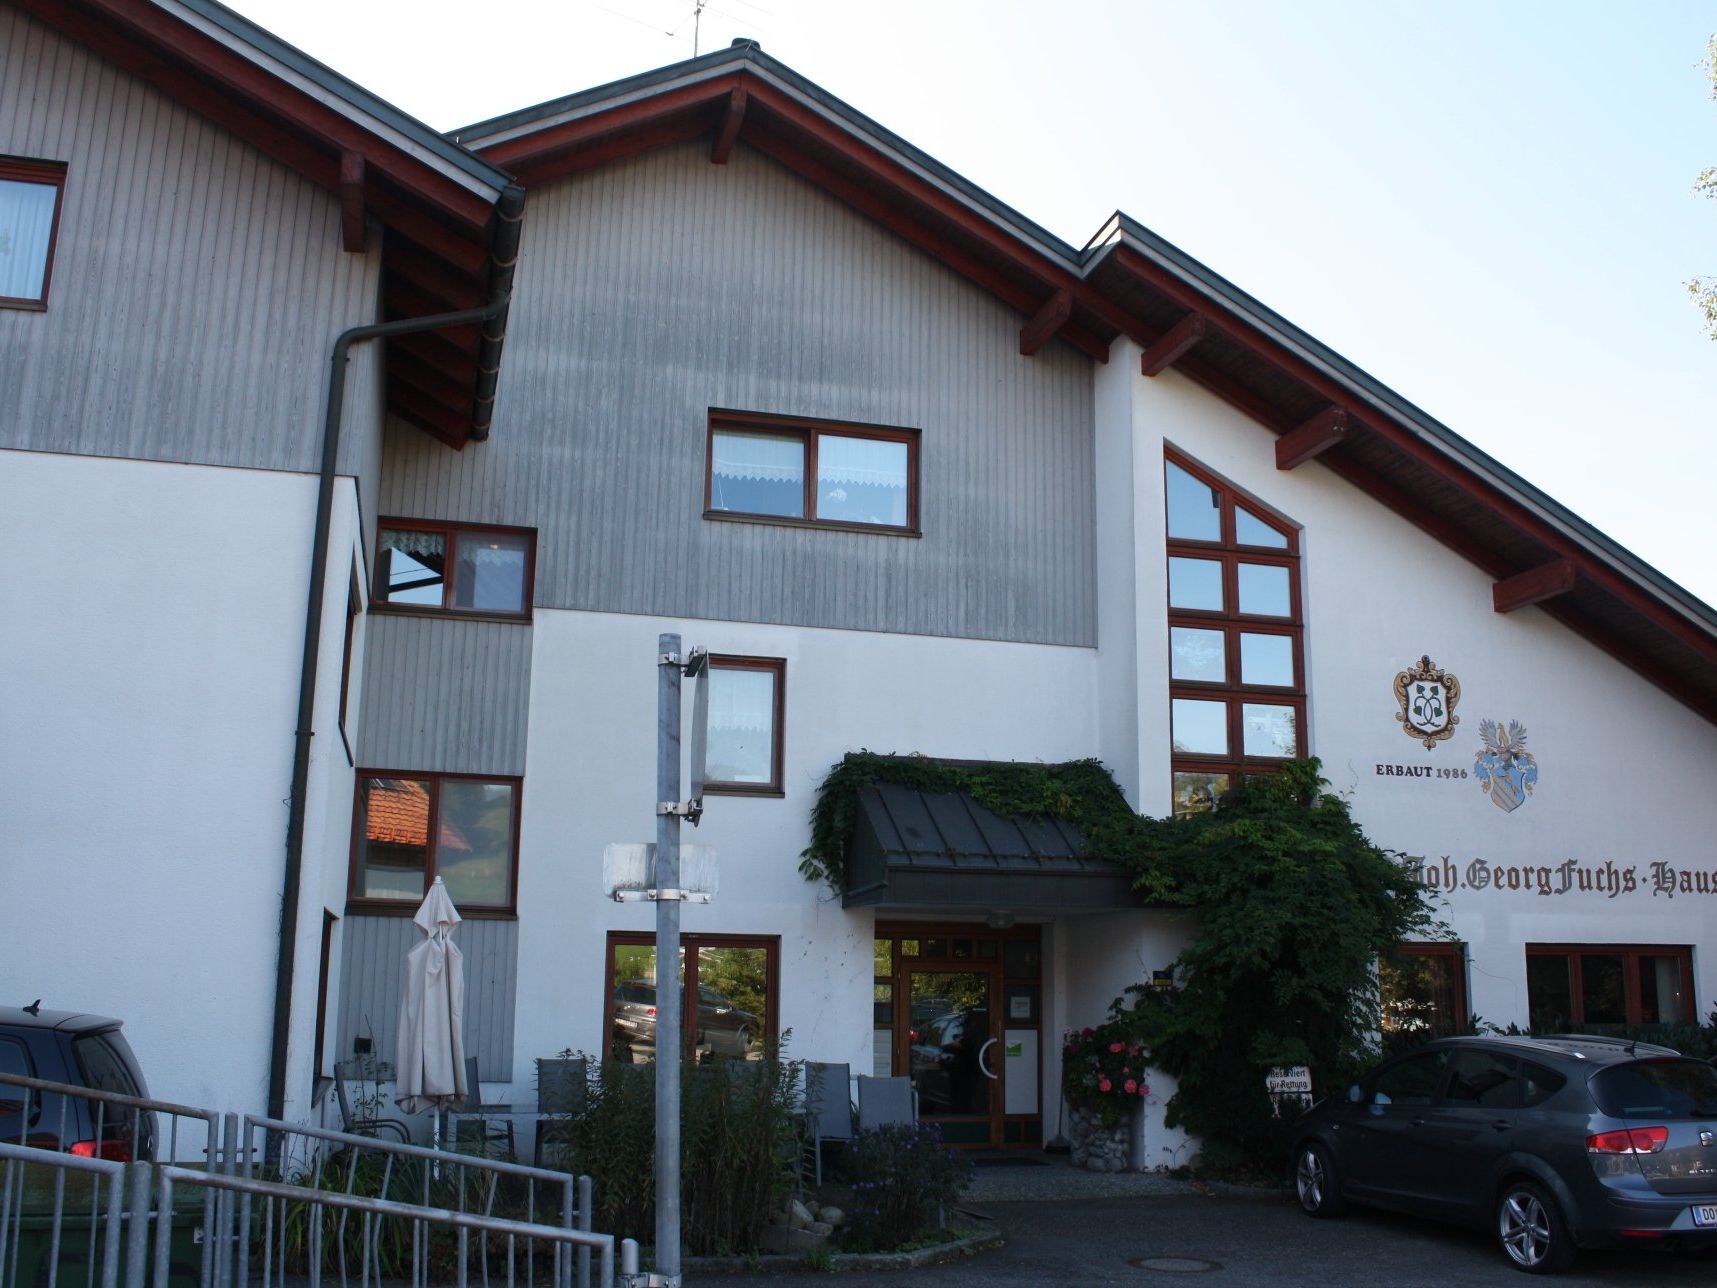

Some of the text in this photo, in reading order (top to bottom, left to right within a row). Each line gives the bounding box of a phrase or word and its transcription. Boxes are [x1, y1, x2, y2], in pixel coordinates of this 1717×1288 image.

[1376, 764, 1468, 779] ERBAUT 1986
[1280, 1079, 1308, 1089] Rettung
